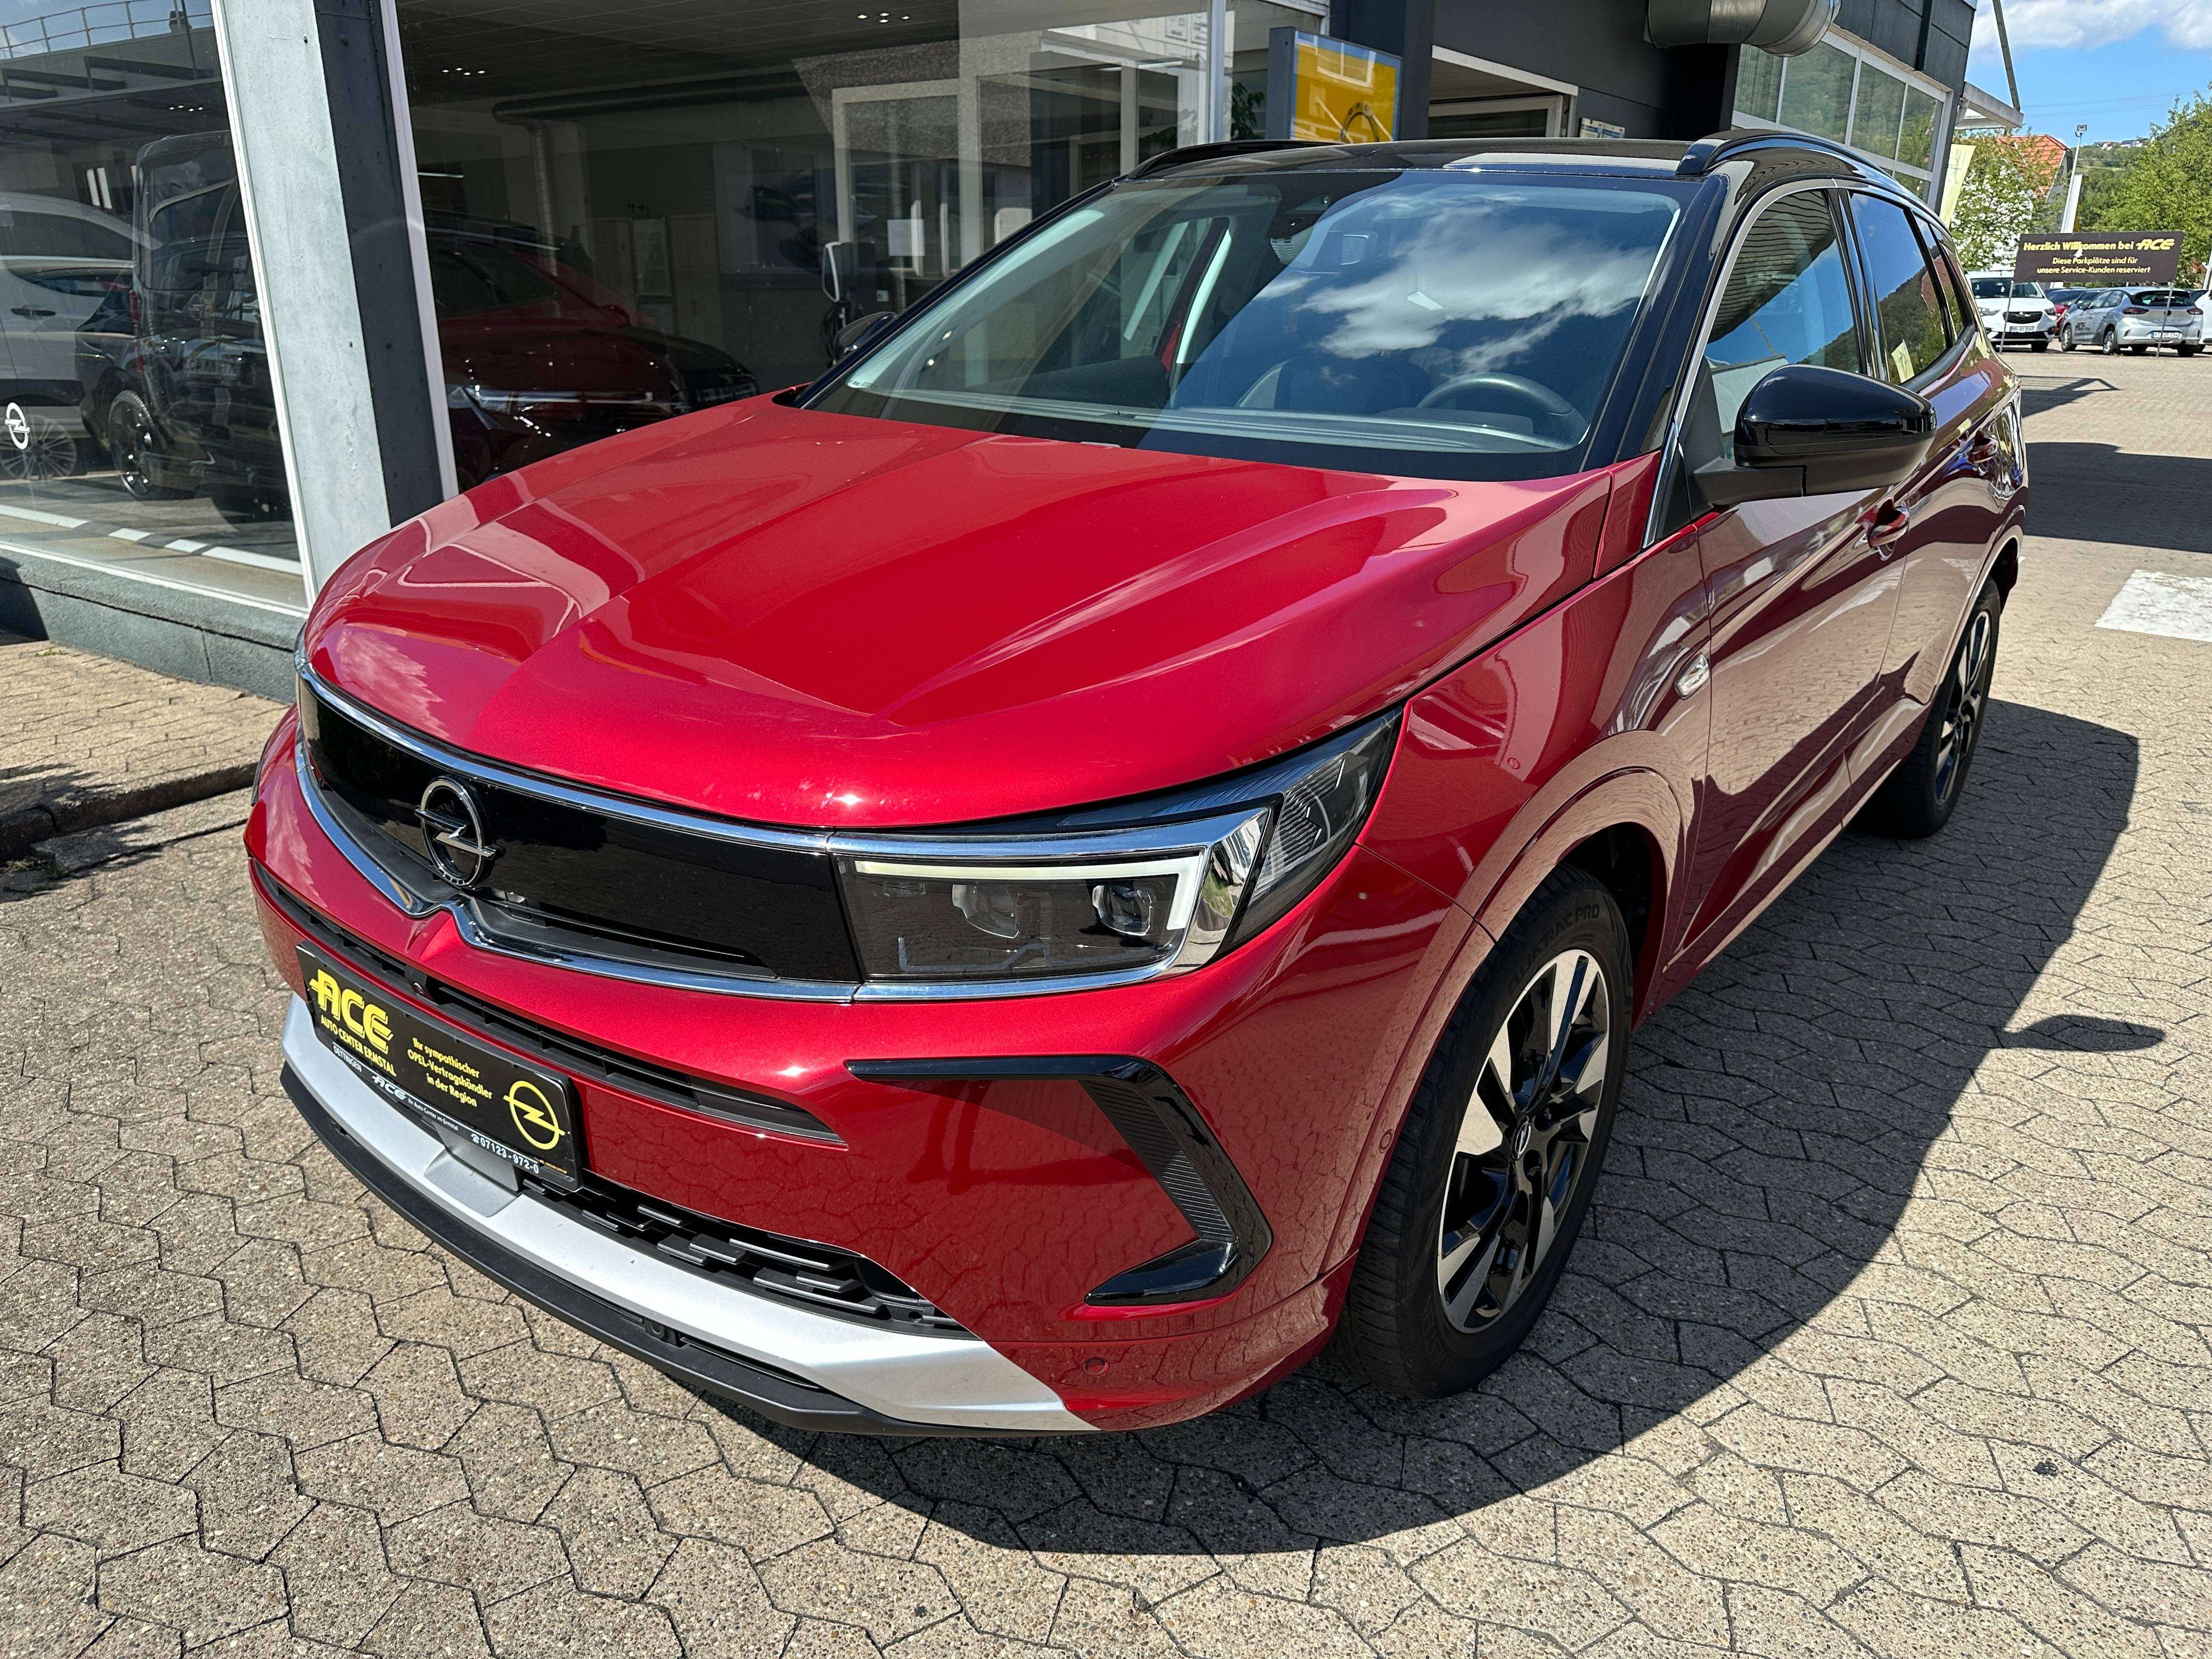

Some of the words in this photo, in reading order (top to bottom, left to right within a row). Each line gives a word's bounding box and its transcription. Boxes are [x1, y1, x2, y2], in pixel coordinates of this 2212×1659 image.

[2023, 241, 2061, 250] Herzlich
[2063, 241, 2116, 250] Willkommen
[2118, 240, 2134, 250] bei
[2136, 239, 2175, 250] ACE
[2073, 256, 2110, 265] Parkplätze
[1576, 904, 1600, 923] PRO
[309, 969, 393, 1054] ACE
[321, 1014, 338, 1035] AUTO
[338, 1028, 364, 1054] CENTER
[364, 1046, 397, 1077] ERMSTAL
[413, 1037, 423, 1051] Ihr
[424, 1045, 479, 1078] sympathischer
[372, 1075, 407, 1100] ACE
[407, 1049, 493, 1099] OPEL-Vertragshändler
[426, 1073, 435, 1085] in
[435, 1078, 448, 1092] der
[449, 1084, 477, 1107] Region
